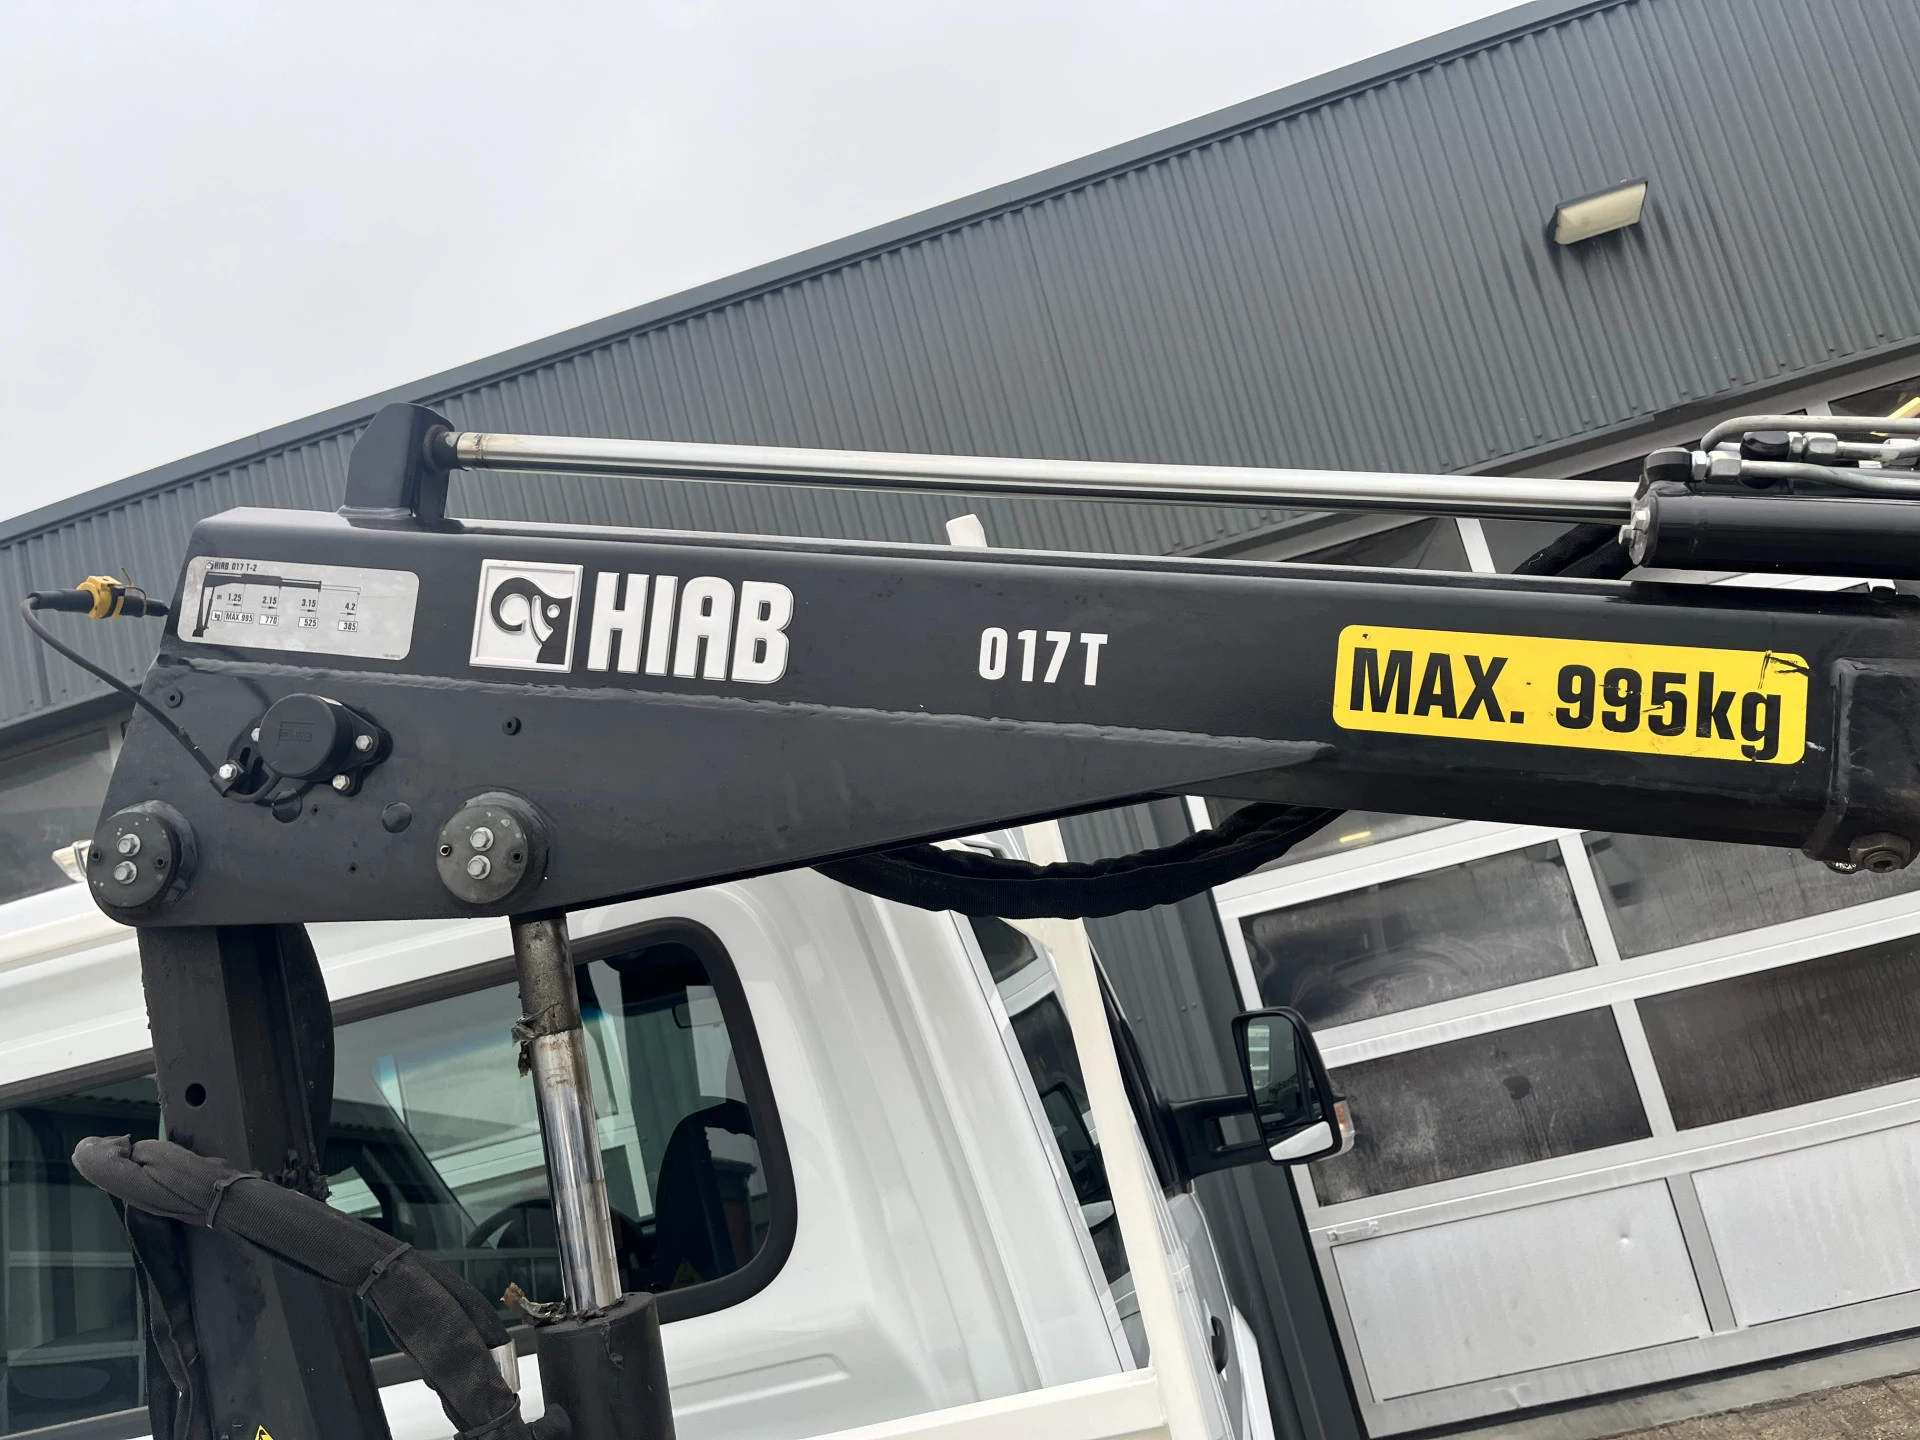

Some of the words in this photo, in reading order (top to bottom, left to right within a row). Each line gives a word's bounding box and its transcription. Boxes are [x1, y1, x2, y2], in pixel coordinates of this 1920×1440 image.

[214, 561, 230, 571] HIAB
[231, 562, 244, 571] 017
[246, 563, 258, 572] T-2
[228, 593, 242, 602] 1.25
[262, 596, 277, 605] 2.15
[301, 599, 316, 608] 3.15
[345, 602, 356, 611] 4.2
[213, 612, 221, 621] kg
[225, 612, 240, 621] MAX
[241, 613, 253, 622] 995
[265, 615, 278, 625] 770
[304, 619, 317, 628] 525
[343, 622, 356, 631] 385
[587, 572, 794, 684] HIAB
[978, 627, 1109, 686] 017T
[1349, 646, 1525, 724] MAX.
[1555, 664, 1782, 760] 995kg
